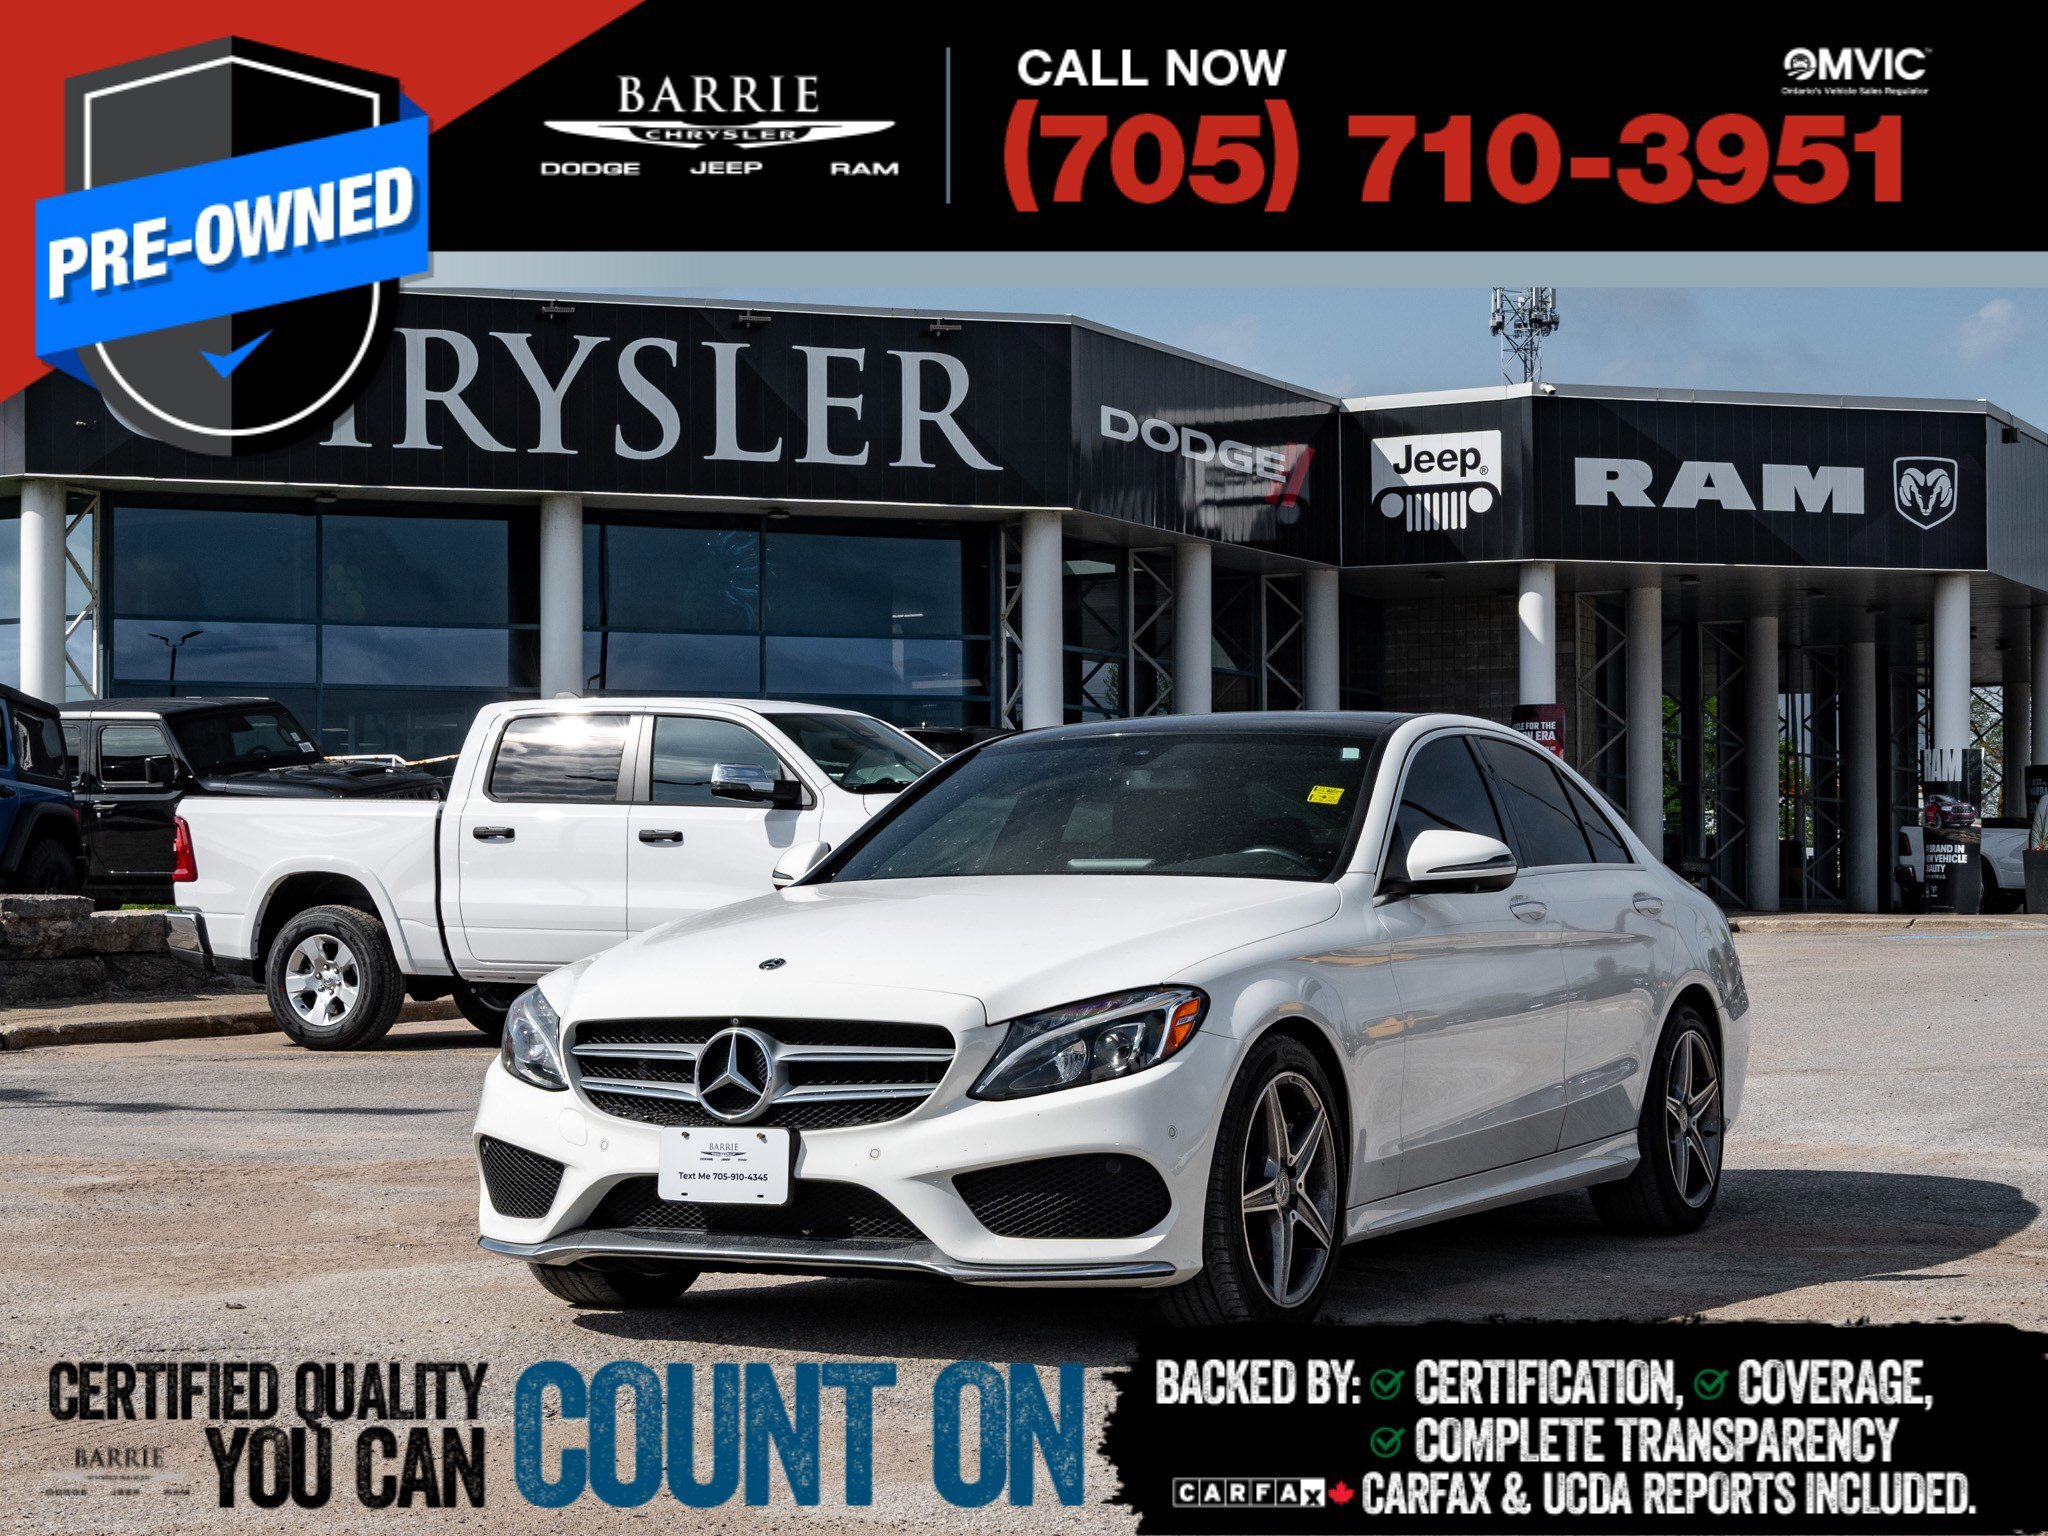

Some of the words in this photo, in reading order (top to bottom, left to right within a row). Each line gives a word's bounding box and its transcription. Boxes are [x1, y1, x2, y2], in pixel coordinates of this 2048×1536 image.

[103, 328, 1004, 471] RYSLER
[1100, 404, 1288, 484] DODGE
[1392, 443, 1482, 478] Jeep
[1574, 456, 1866, 516] RAM
[1526, 722, 1539, 730] FOR
[1541, 721, 1556, 730] THE
[1536, 731, 1556, 740] ERA
[1923, 748, 1963, 782] RAM
[1954, 844, 1965, 854] IN
[1934, 854, 1968, 864] VEHICLE
[709, 1142, 739, 1151] BARRIE
[678, 1172, 696, 1181] Text
[698, 1172, 711, 1181] Me
[713, 1172, 768, 1181] 705-910-4345
